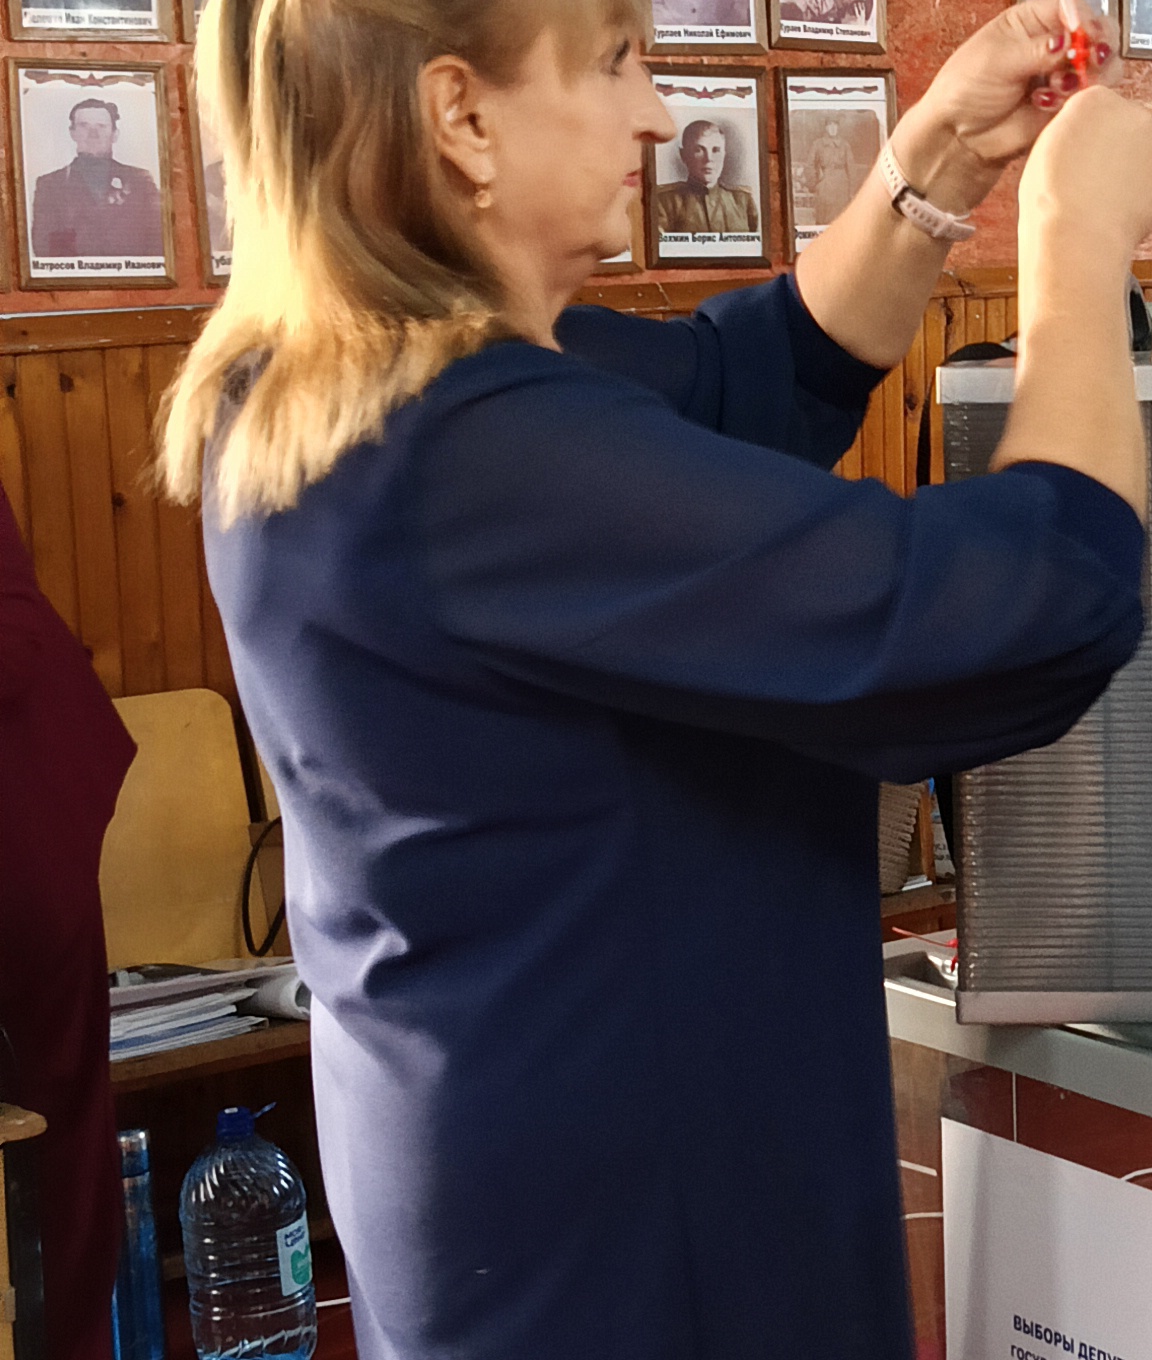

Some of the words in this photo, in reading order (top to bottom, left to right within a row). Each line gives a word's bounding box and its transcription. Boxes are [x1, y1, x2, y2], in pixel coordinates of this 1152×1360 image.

[683, 27, 714, 38] Николай
[715, 28, 752, 39] Ефимович
[802, 24, 834, 36] Владимир
[835, 26, 871, 37] Степанович
[691, 232, 717, 245] Борис
[32, 259, 76, 272] Матросов
[77, 260, 122, 272] Владимир
[1013, 1314, 1075, 1354] ВЫБОРЫ
